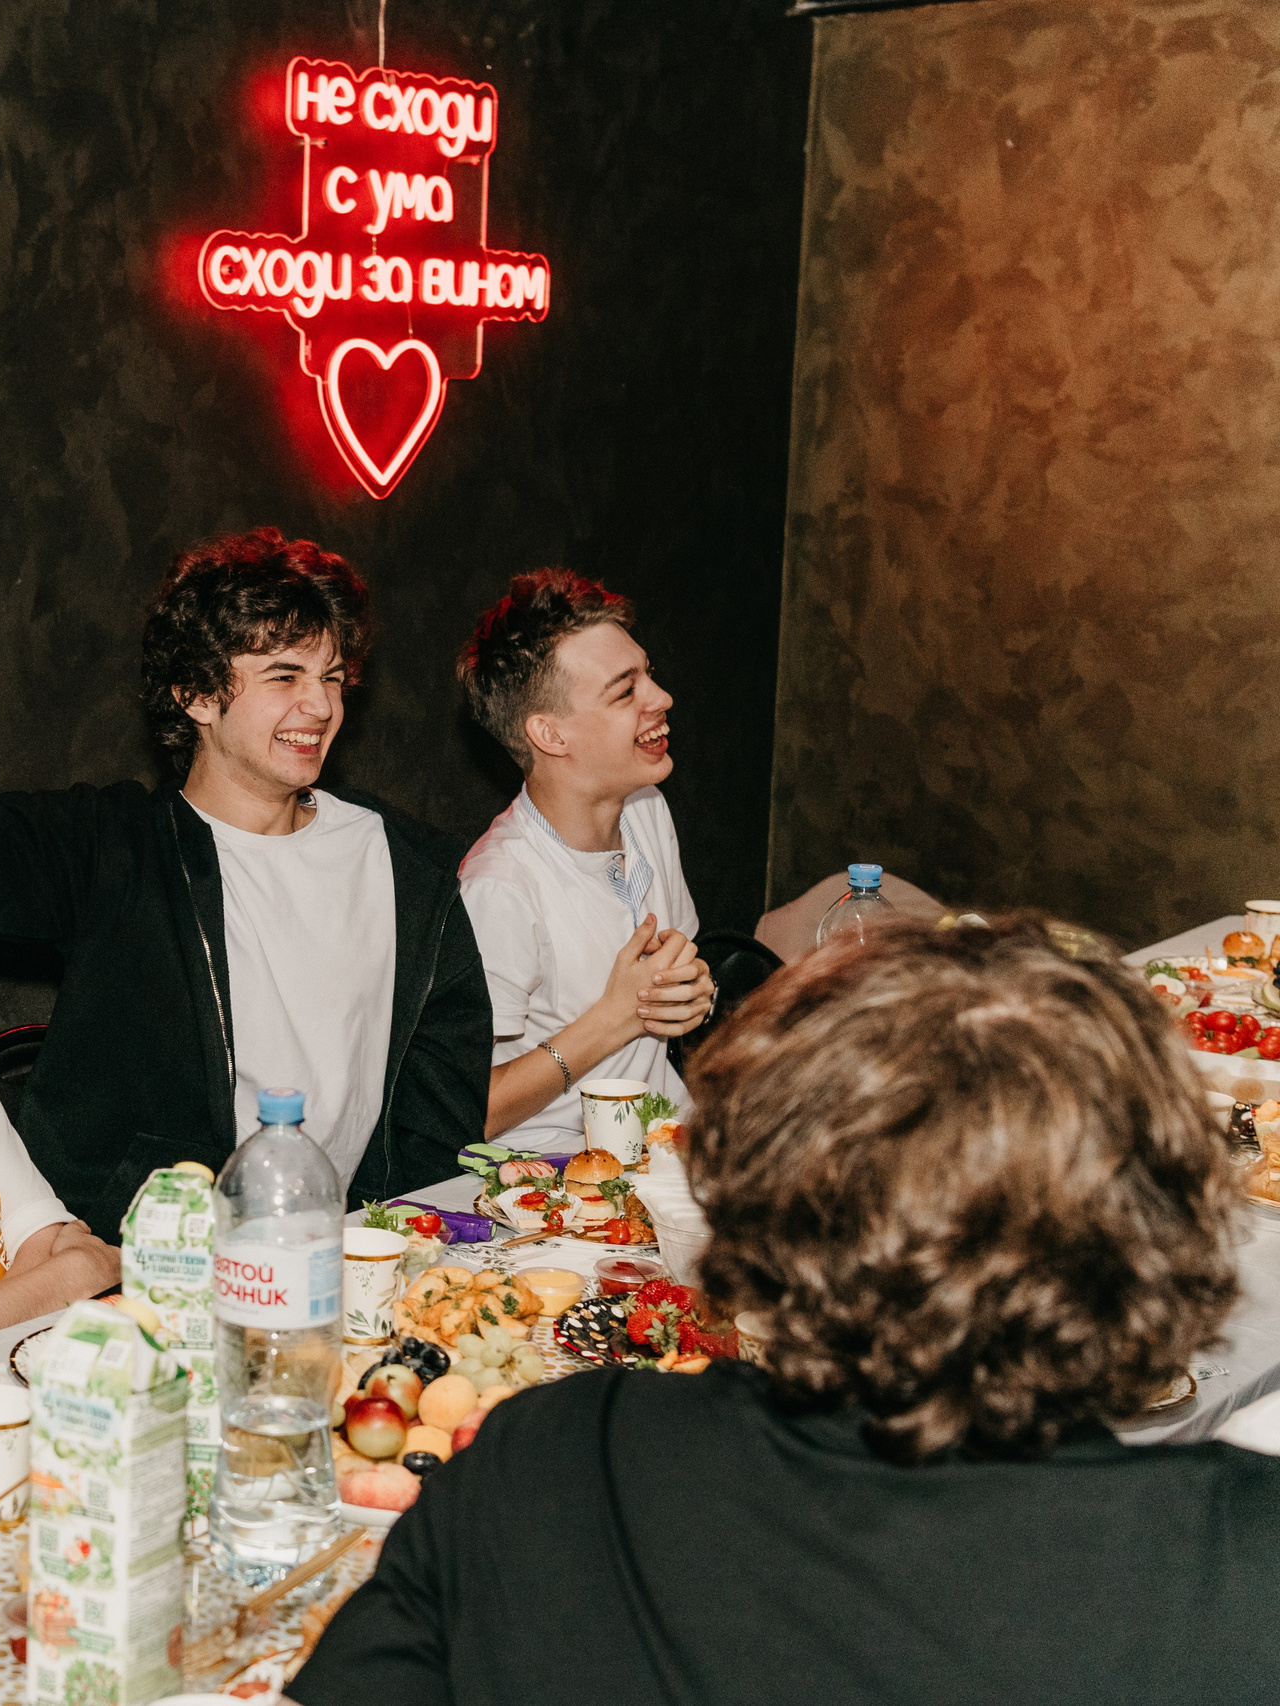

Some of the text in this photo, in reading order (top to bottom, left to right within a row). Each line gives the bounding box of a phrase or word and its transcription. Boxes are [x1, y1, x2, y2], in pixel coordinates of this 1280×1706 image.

[362, 80, 493, 158] сходи
[365, 168, 454, 236] ума
[210, 244, 547, 319] сходи за вином
